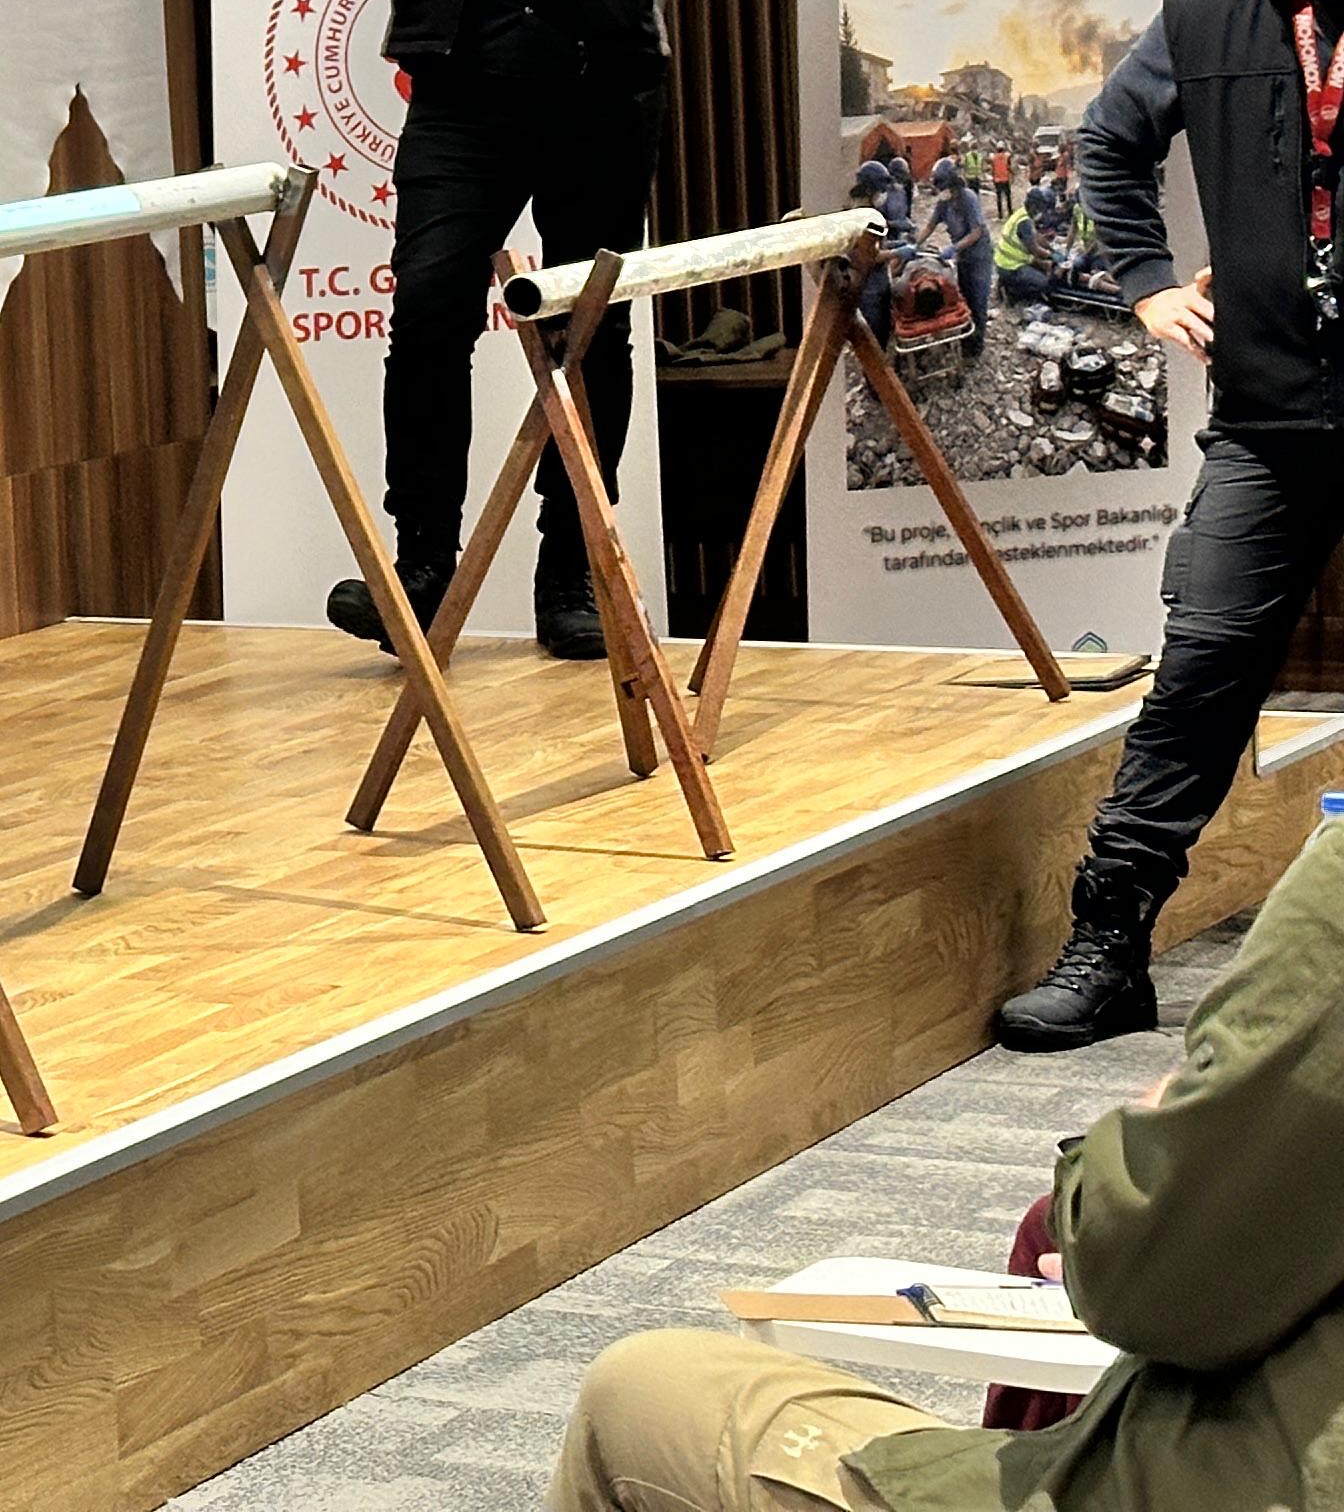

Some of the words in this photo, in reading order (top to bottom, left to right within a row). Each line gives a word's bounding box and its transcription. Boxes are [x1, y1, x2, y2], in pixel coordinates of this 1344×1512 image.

[334, 97, 397, 164] ÜRKİYE
[298, 266, 361, 298] T.C.
[292, 309, 386, 344] SPOR
[900, 523, 952, 545] proje,
[979, 516, 1022, 538] nçlik
[1026, 517, 1048, 531] ve
[1050, 511, 1092, 532] Spor
[1096, 503, 1179, 526] Bakanlığı
